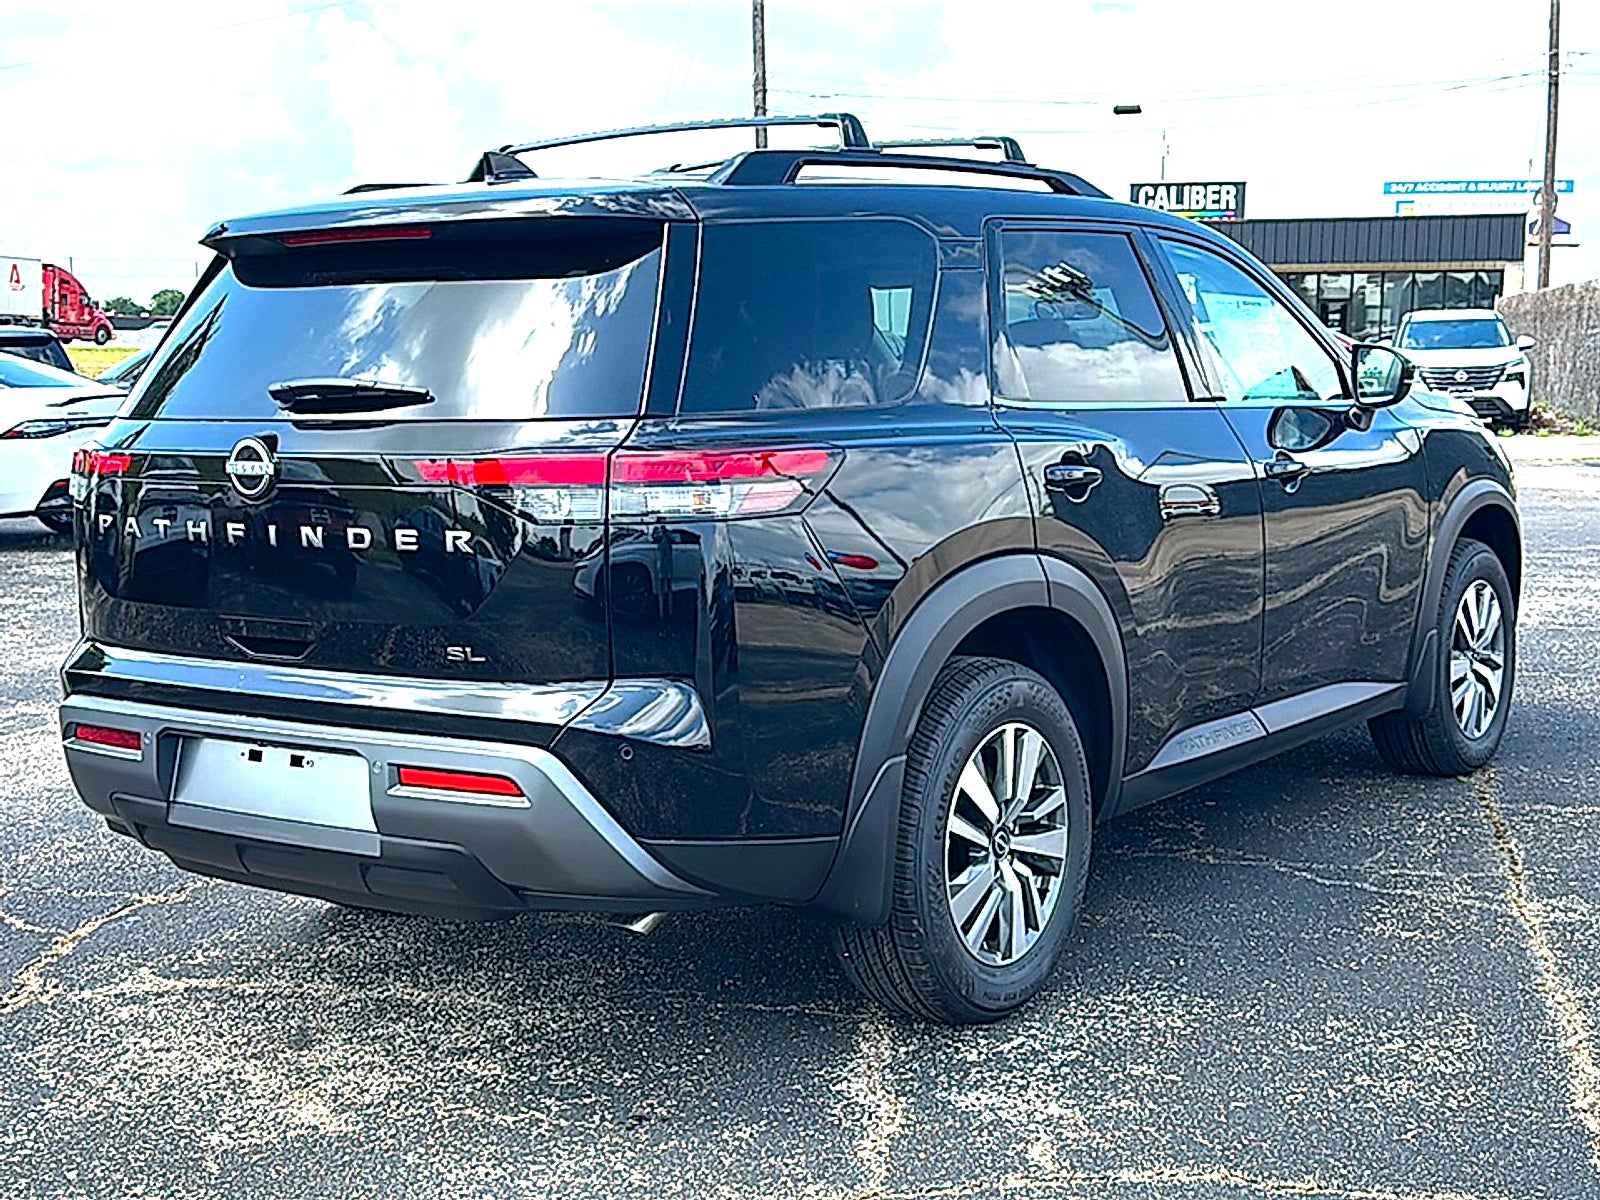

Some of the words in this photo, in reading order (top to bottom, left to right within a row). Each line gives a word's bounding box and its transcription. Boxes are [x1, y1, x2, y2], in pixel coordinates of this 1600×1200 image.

[1138, 184, 1236, 210] CALIBER
[1390, 183, 1414, 192] 24/7
[1415, 182, 1467, 192] ACCIDENT
[229, 463, 272, 475] NISSAN
[99, 514, 474, 553] PATHFINDER
[446, 646, 486, 662] SL
[933, 746, 963, 842] KUMHO
